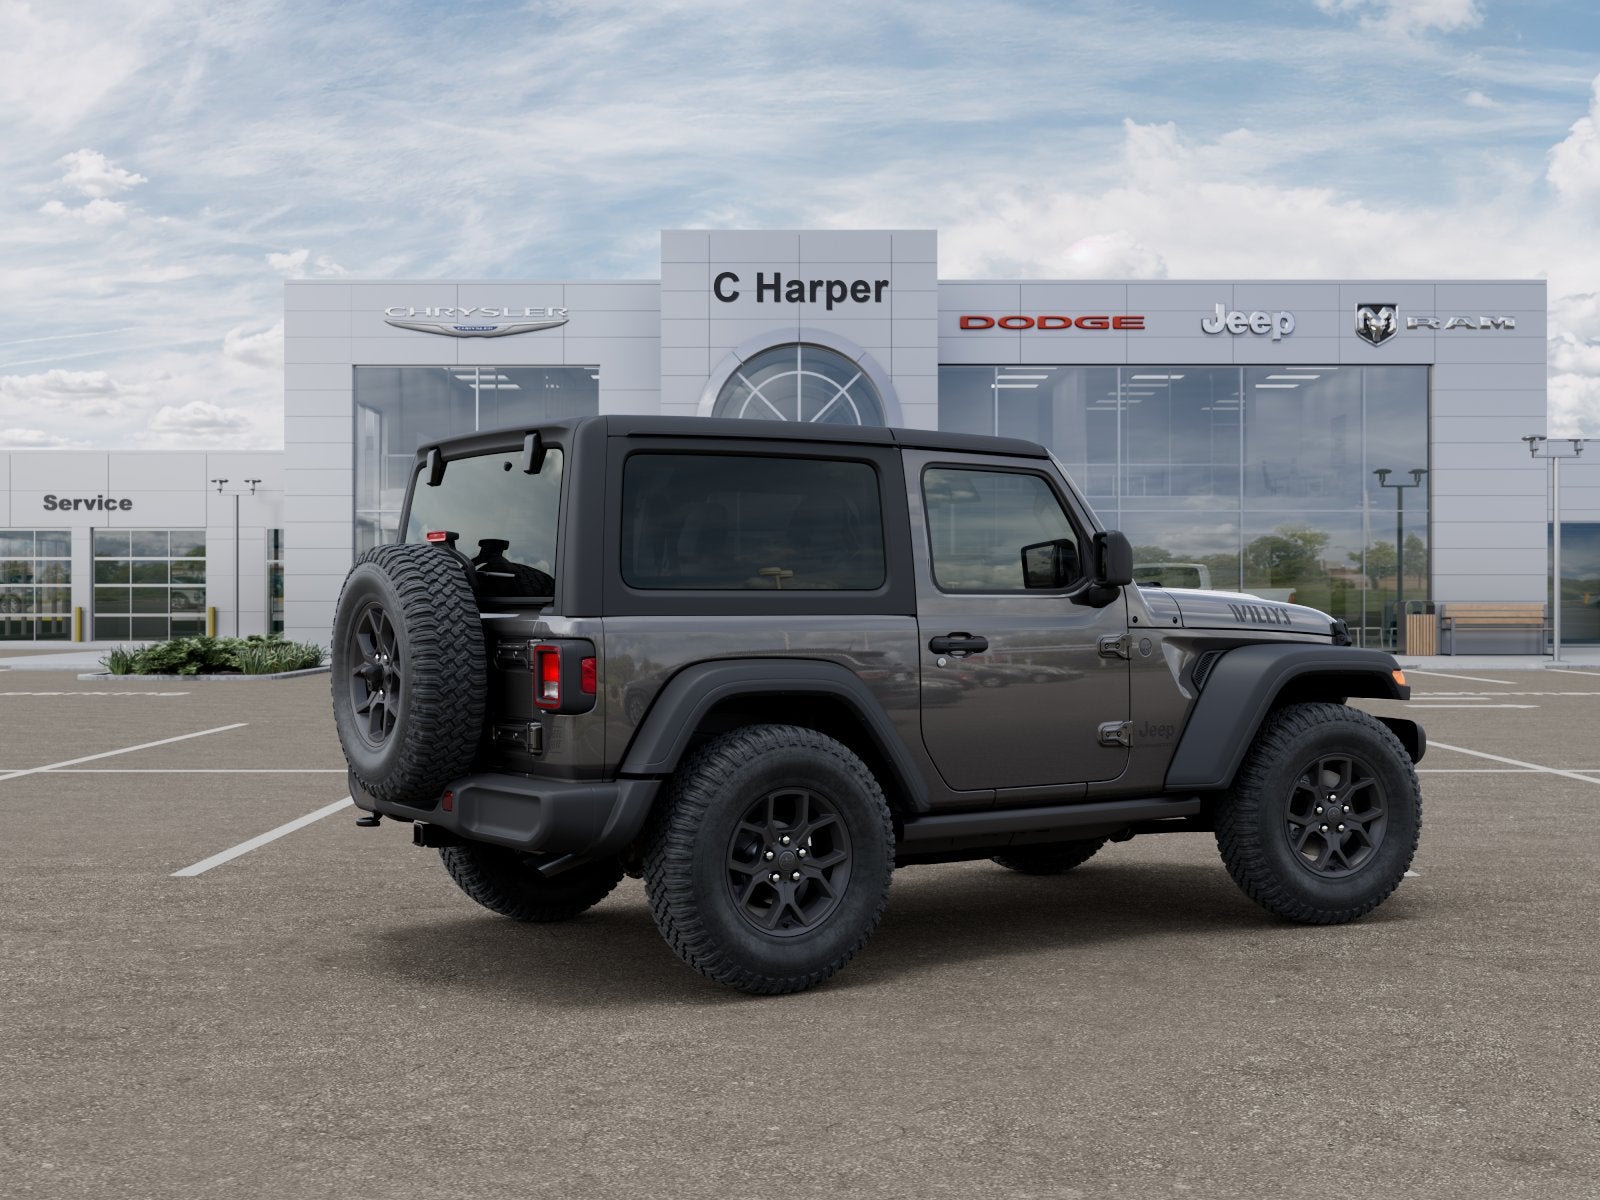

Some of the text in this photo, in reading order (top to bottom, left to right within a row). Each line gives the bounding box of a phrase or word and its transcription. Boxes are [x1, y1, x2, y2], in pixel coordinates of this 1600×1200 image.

[713, 271, 890, 310] C Harper
[384, 306, 568, 318] CHRYSLER
[959, 315, 1146, 330] DODGE
[1201, 303, 1295, 341] Jeep
[1406, 316, 1515, 330] RAM
[43, 494, 133, 511] Service
[1227, 603, 1292, 625] WILLYS
[1138, 720, 1175, 740] Jeep
